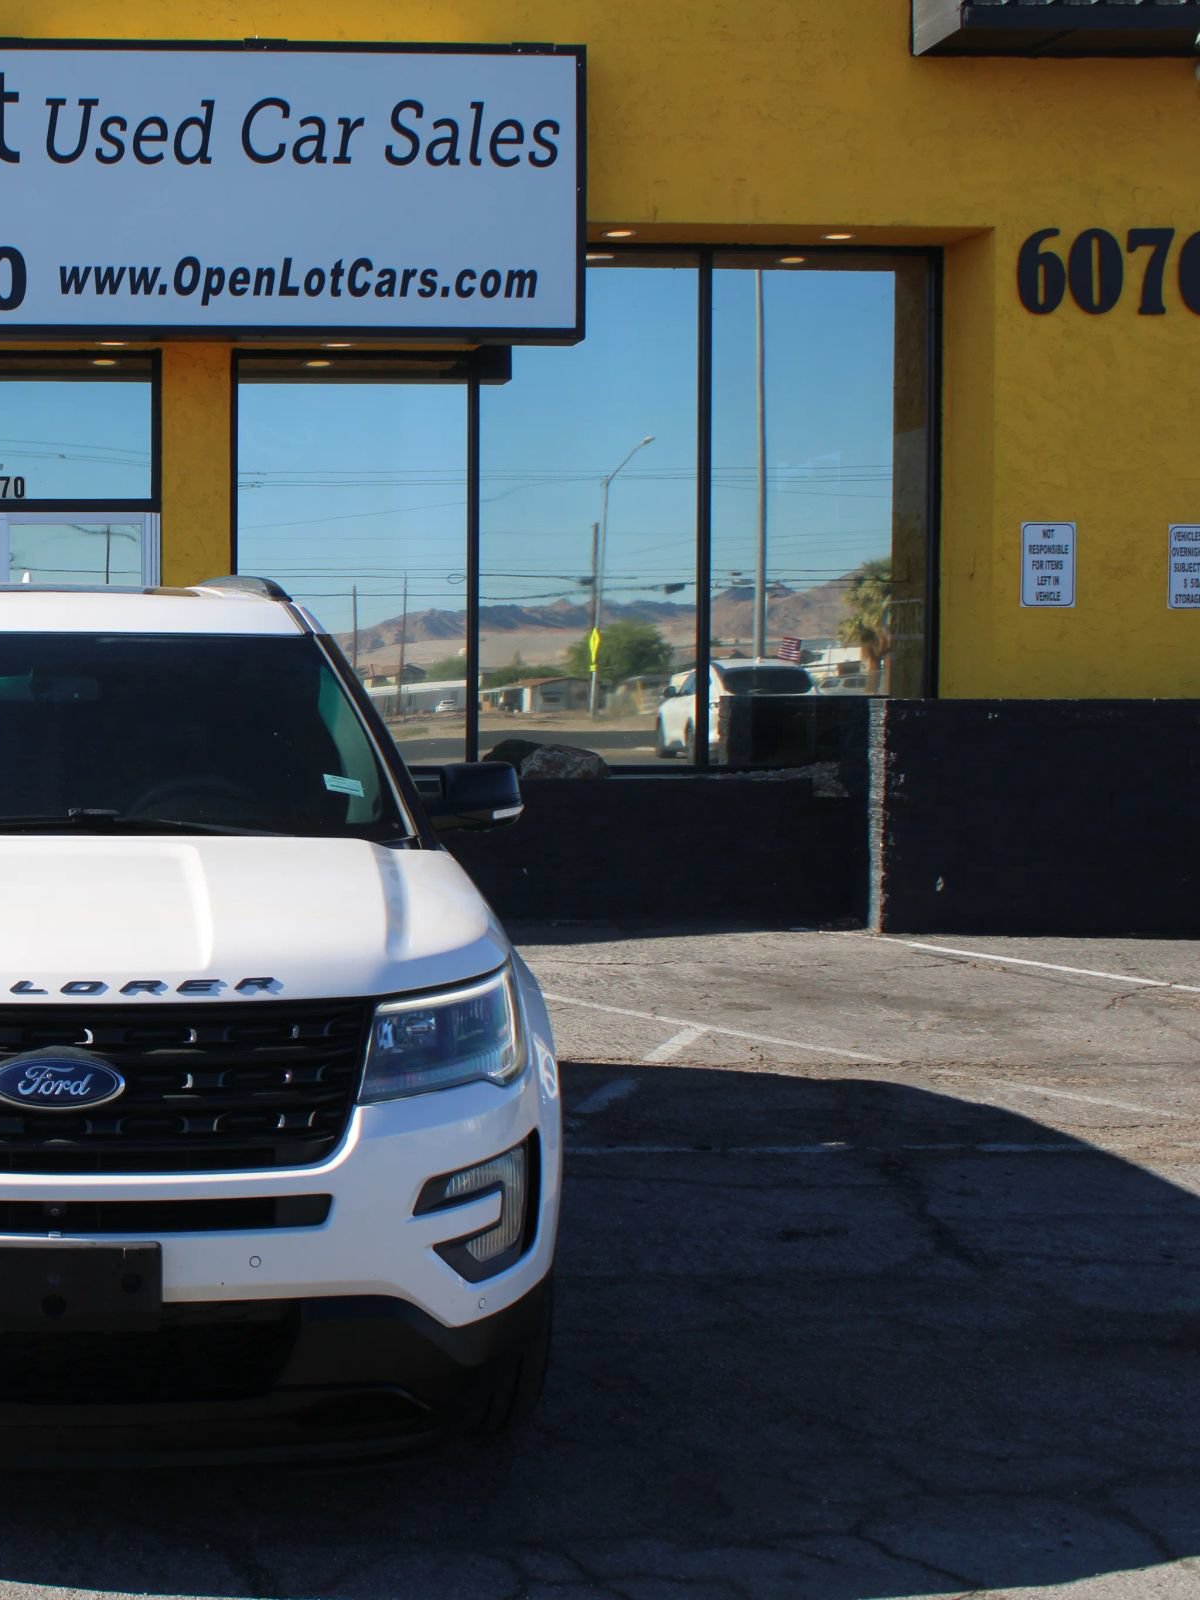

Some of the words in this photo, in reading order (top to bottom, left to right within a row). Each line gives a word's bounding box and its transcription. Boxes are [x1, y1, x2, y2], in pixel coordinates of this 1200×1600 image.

[45, 98, 215, 165] Used
[241, 97, 365, 165] Car
[384, 99, 561, 168] Sales
[59, 256, 538, 306] www.OpenLotCars.com
[1042, 529, 1055, 539] NOT
[1028, 544, 1069, 555] RESPONSIBLE
[1032, 560, 1044, 570] FOR
[1045, 560, 1063, 570] ITEMS
[1037, 576, 1052, 586] LEFT
[1052, 576, 1060, 586] IN
[1035, 591, 1061, 602] VEHICLE
[18, 1065, 94, 1095] Ford
